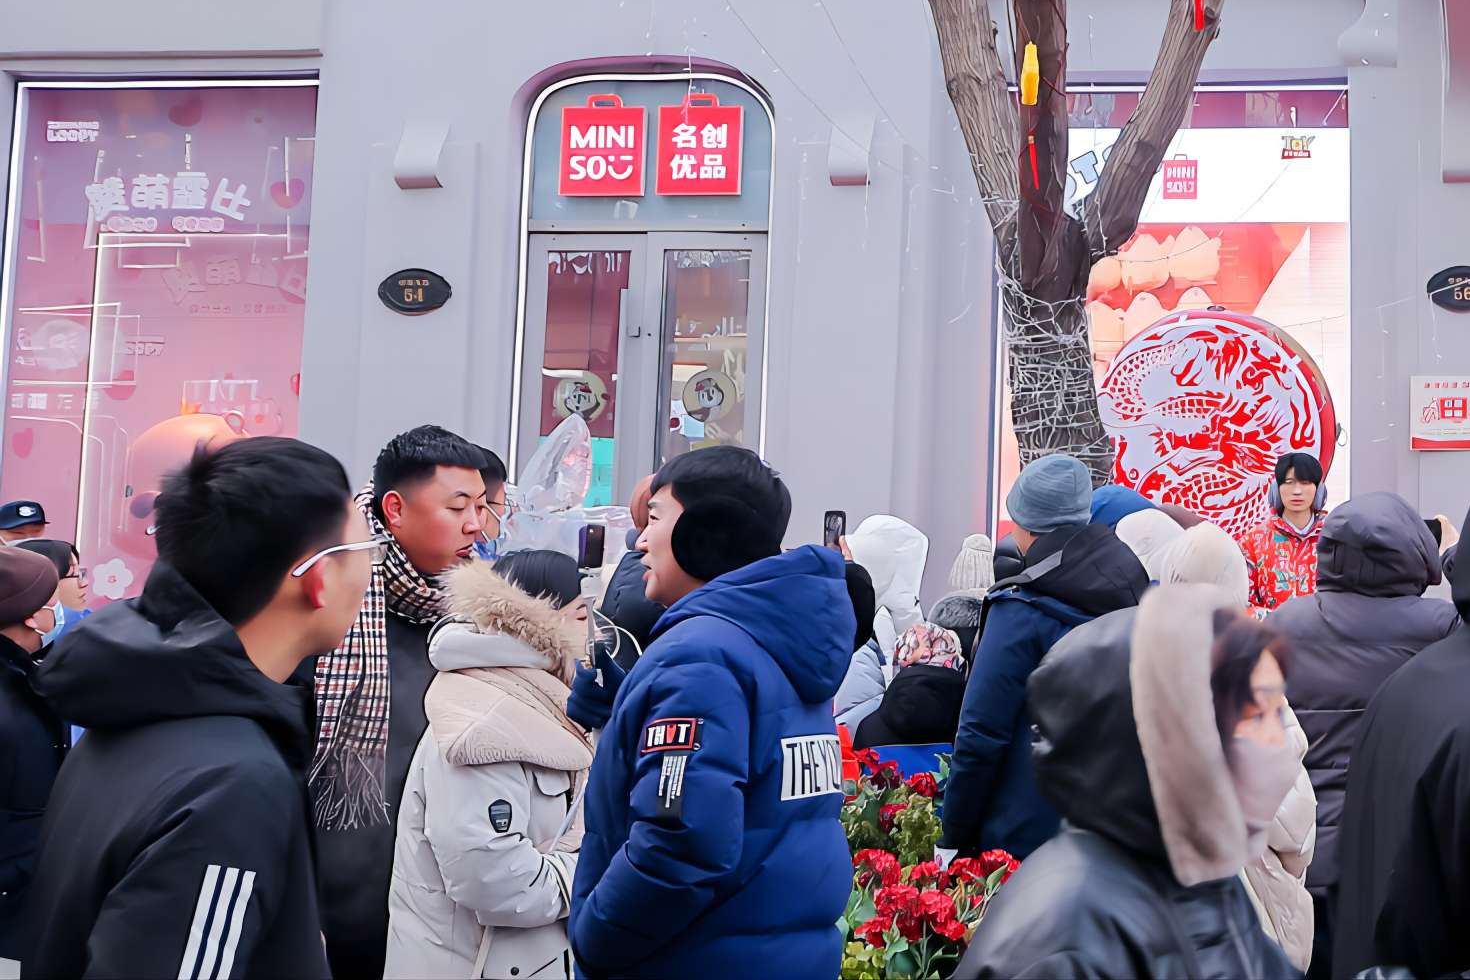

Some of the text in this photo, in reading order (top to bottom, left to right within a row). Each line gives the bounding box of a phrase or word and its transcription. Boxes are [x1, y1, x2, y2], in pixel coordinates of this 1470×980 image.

[569, 124, 635, 149] MINI
[671, 123, 728, 149] 名创
[669, 153, 727, 180] 优品
